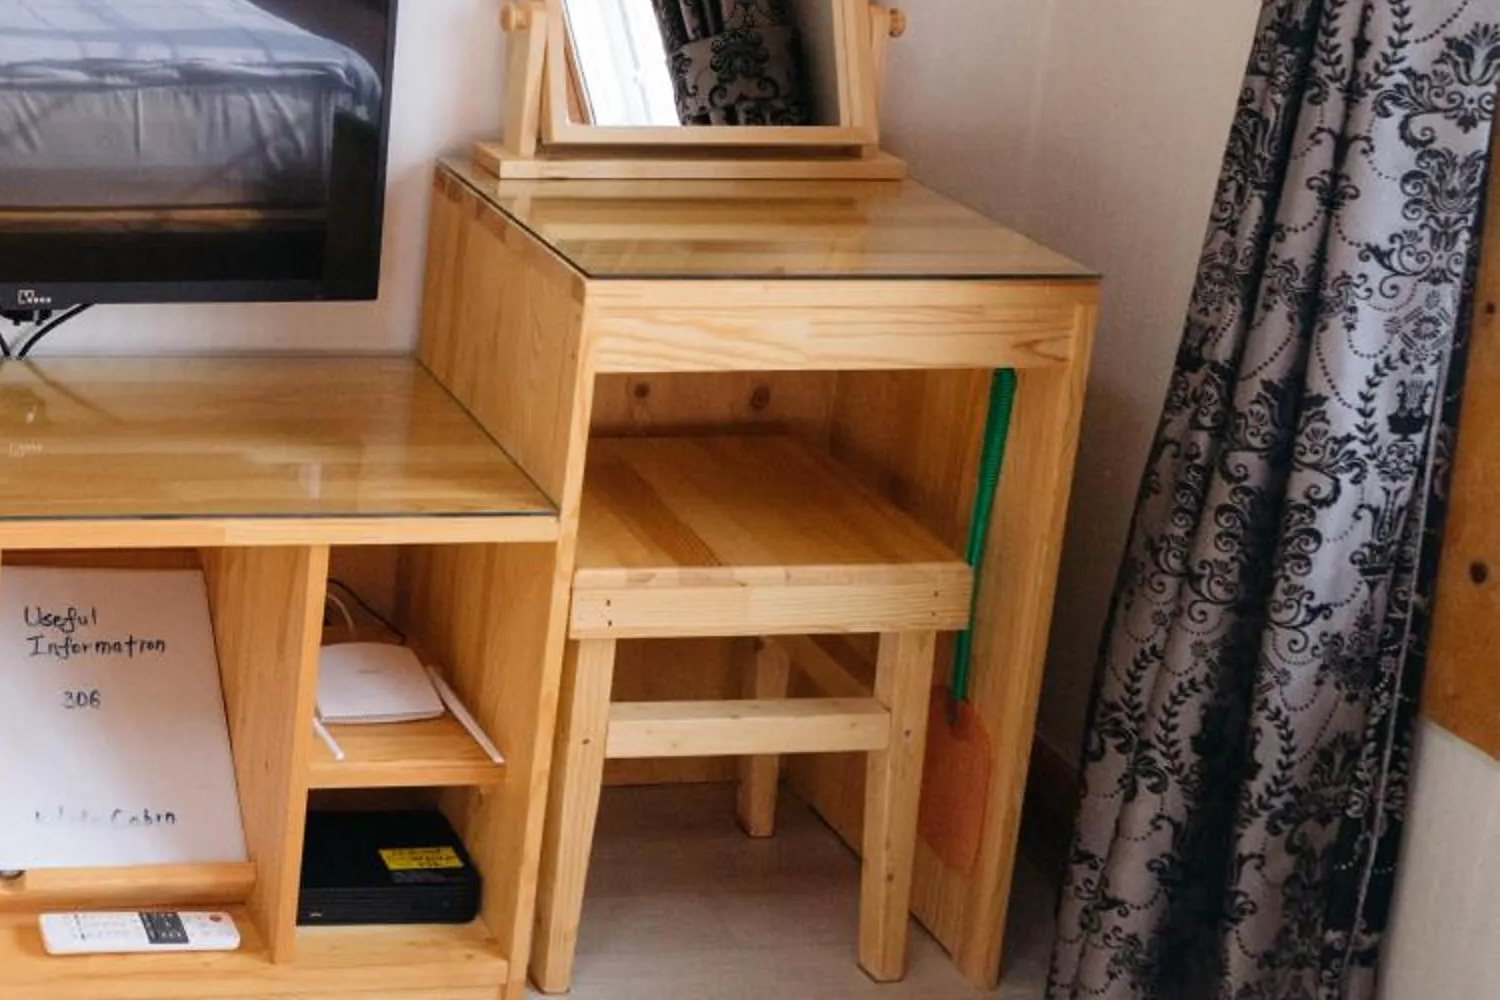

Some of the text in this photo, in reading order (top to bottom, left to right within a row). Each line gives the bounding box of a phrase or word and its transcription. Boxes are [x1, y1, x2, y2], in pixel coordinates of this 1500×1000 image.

[24, 606, 97, 633] Useful
[26, 633, 166, 660] Information
[62, 689, 102, 711] 306
